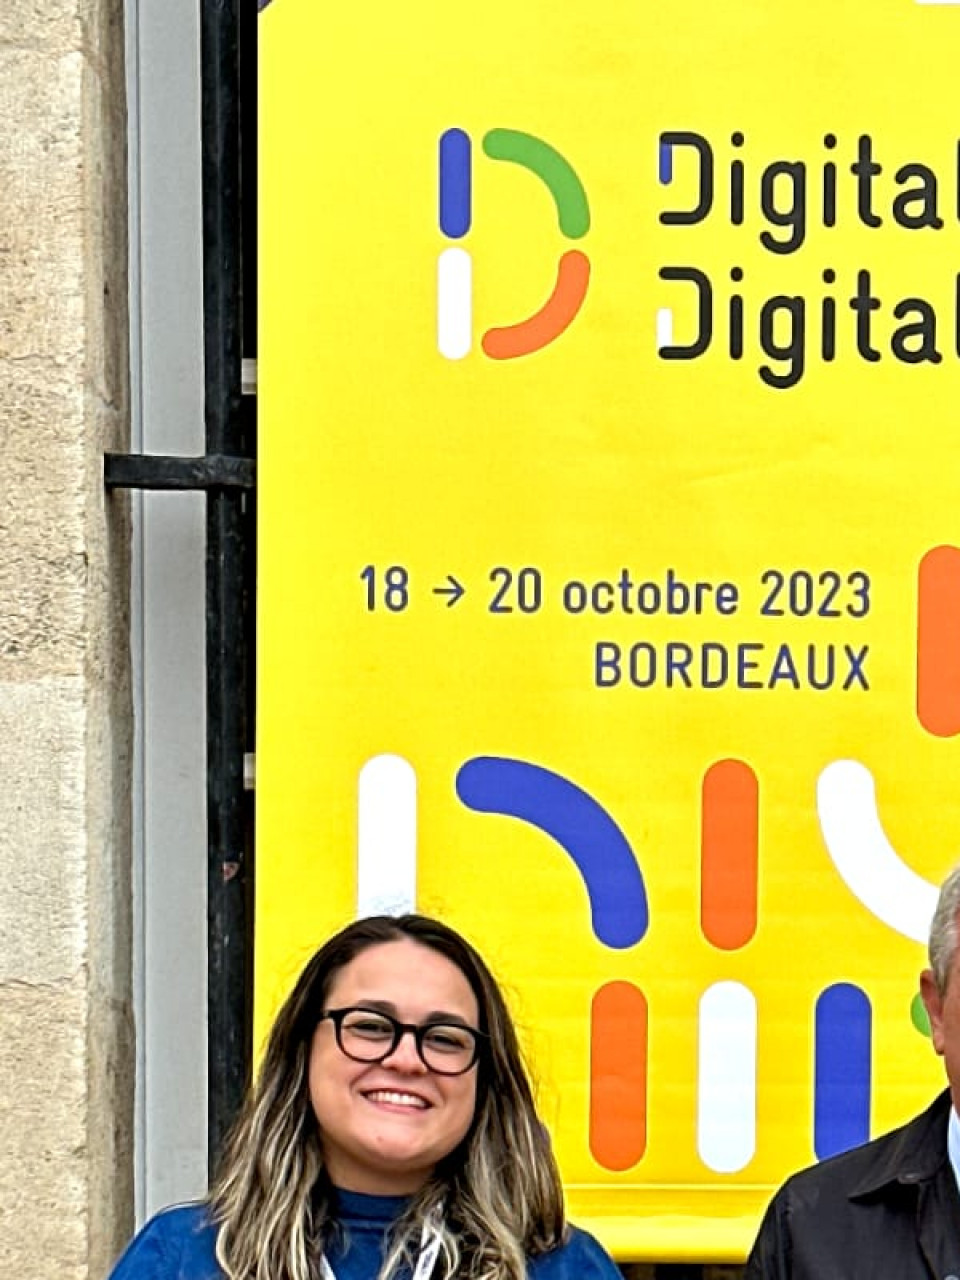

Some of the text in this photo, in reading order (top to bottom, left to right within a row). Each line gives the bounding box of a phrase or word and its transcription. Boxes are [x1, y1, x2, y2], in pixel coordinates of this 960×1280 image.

[360, 565, 870, 618] 18 20 octobre 2023
[594, 642, 869, 691] BORDEAUX
